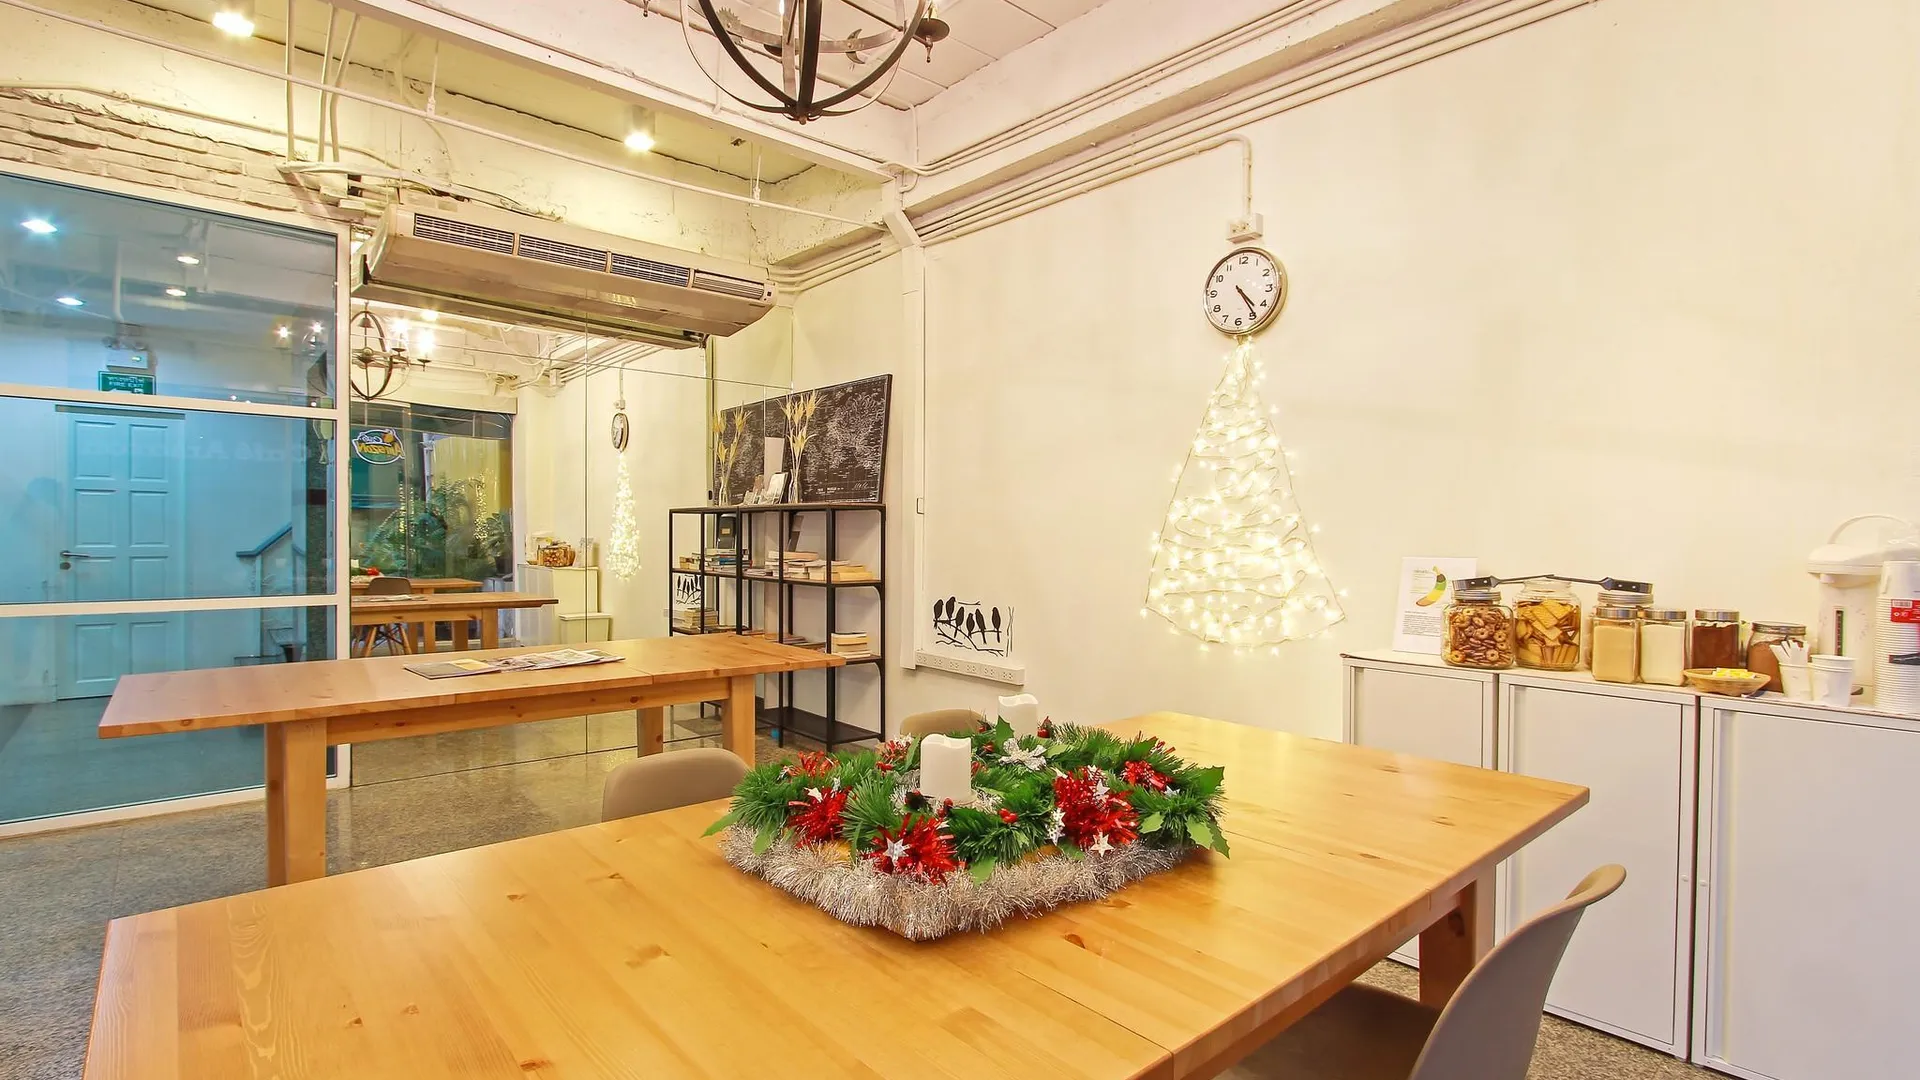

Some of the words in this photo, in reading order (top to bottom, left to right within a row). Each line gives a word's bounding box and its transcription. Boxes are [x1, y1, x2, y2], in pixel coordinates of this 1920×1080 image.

[1238, 256, 1249, 265] 12
[1255, 258, 1259, 266] 1
[1226, 264, 1232, 272] 11
[1262, 268, 1270, 277] 2
[1215, 274, 1224, 283] 10
[1265, 283, 1273, 293] 3
[1209, 289, 1218, 298] 9
[1259, 299, 1267, 308] 4
[1212, 304, 1221, 313] 8
[1222, 314, 1229, 323] 7
[1248, 311, 1257, 321] 5
[1234, 317, 1243, 326] 6
